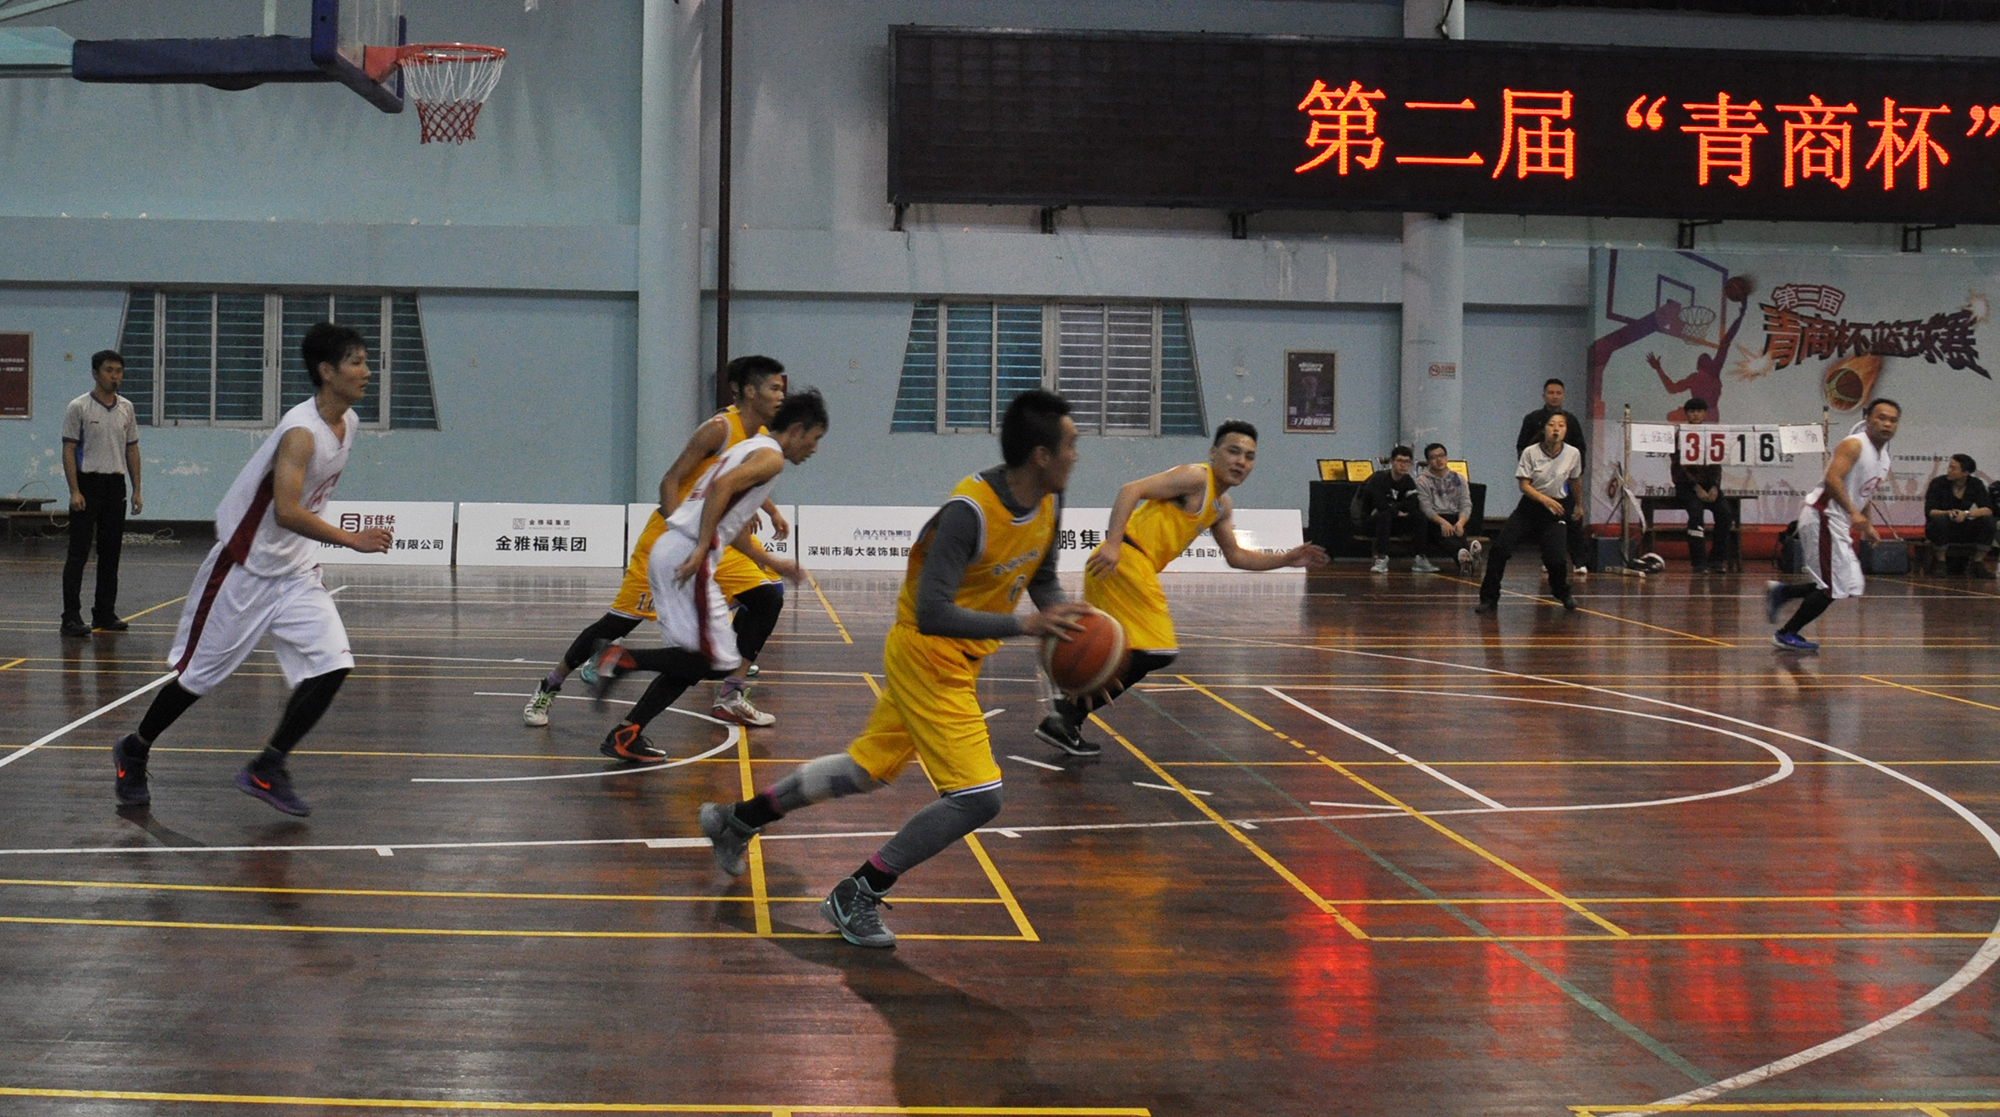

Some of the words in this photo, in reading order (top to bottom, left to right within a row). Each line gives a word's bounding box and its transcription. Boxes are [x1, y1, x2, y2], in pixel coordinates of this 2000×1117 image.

[1760, 303, 1992, 381] 青商杯篮球赛
[364, 514, 395, 526] 百佳华
[495, 535, 587, 552] 金雅福集团
[1057, 529, 1110, 550] 鹏集
